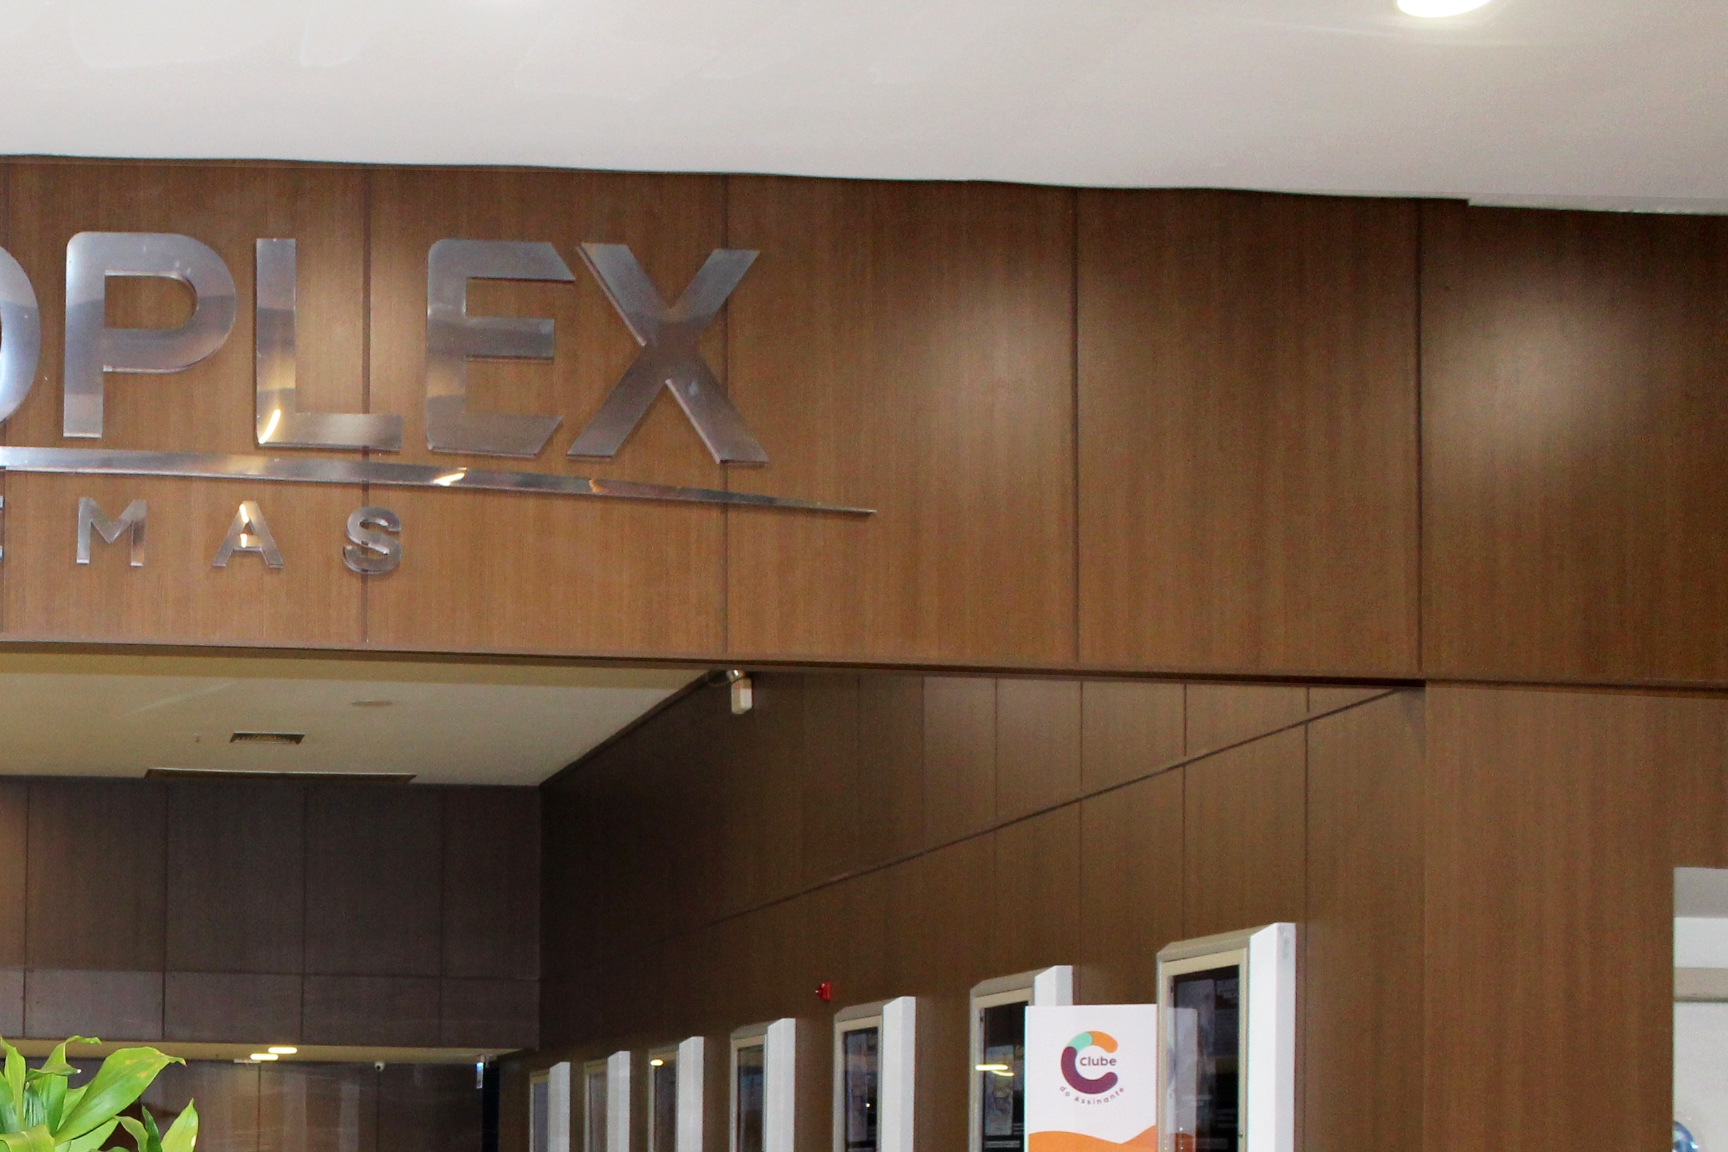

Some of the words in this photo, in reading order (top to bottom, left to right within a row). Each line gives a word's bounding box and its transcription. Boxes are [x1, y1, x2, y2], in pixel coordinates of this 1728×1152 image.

[1079, 1056, 1117, 1066] Clube
[1059, 1085, 1071, 1097] do
[1074, 1086, 1125, 1105] Assinante
